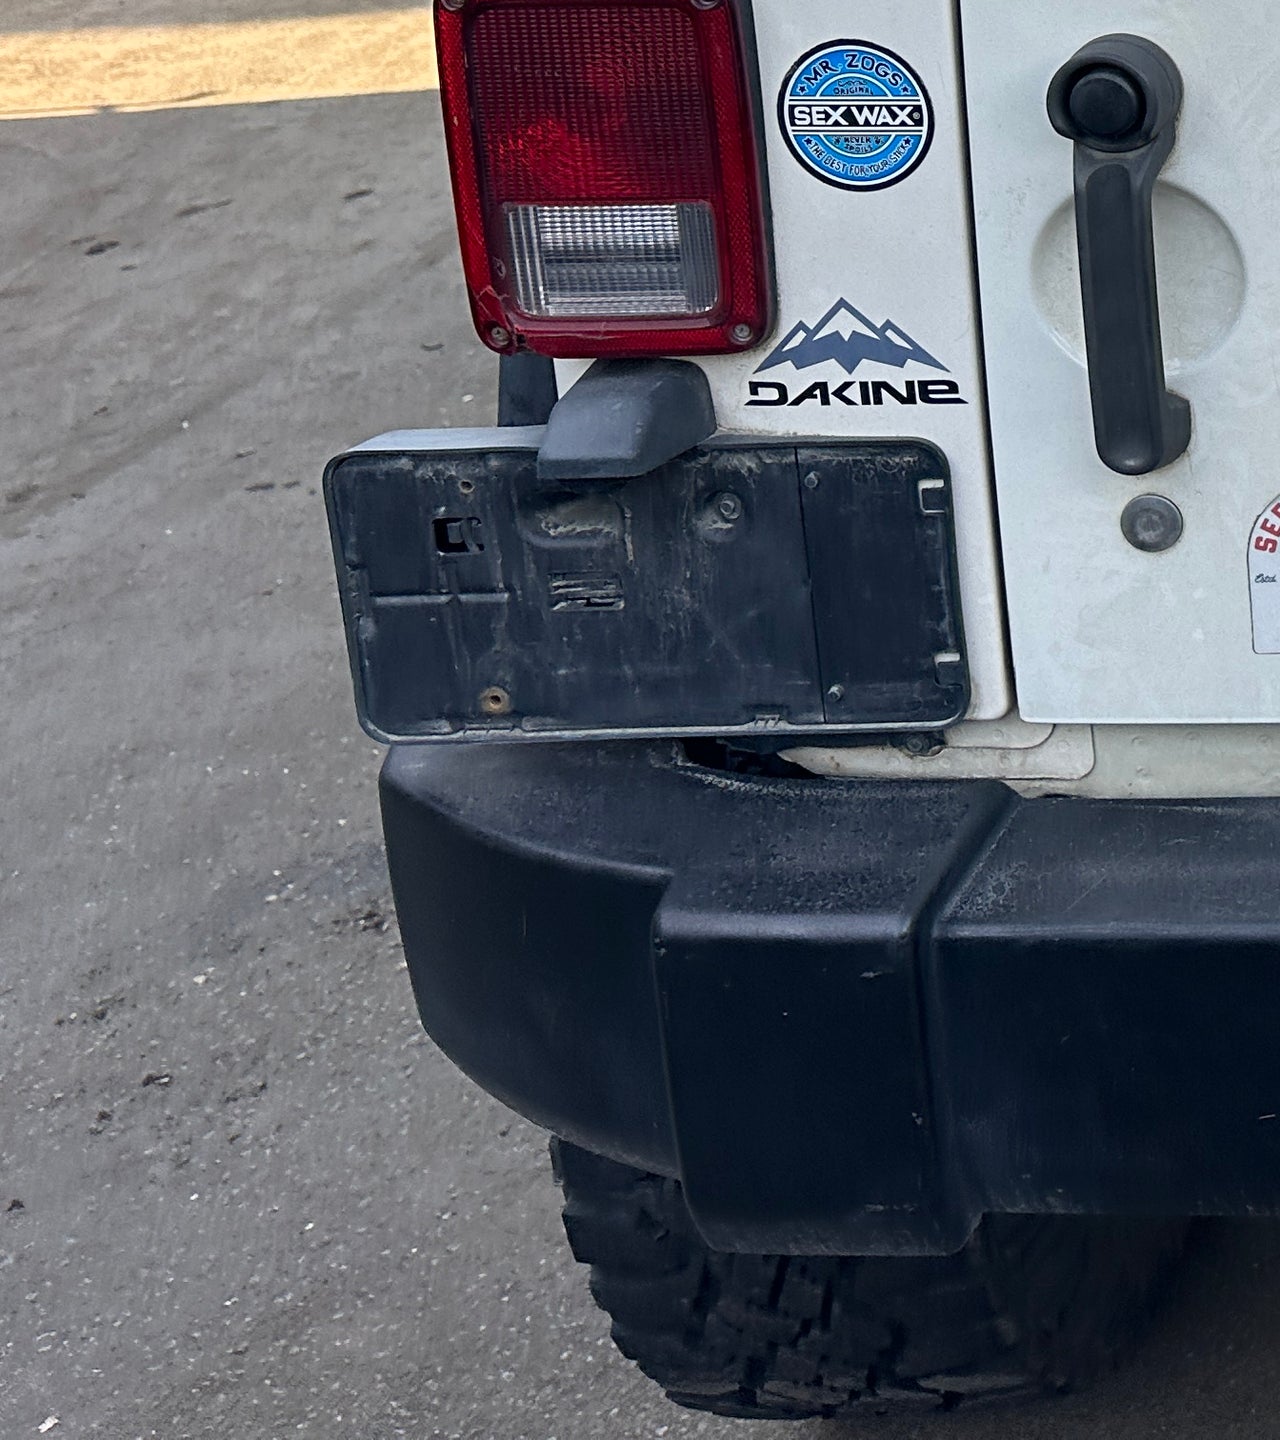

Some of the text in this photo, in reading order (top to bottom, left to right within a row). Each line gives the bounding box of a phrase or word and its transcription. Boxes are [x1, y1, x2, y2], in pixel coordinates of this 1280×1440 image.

[845, 53, 903, 87] ZOGS
[833, 87, 873, 95] ORIGINAL
[794, 106, 849, 126] SEX
[810, 142, 909, 176] THE BEST FOR YOUR STICK
[744, 379, 969, 406] DAKINE
